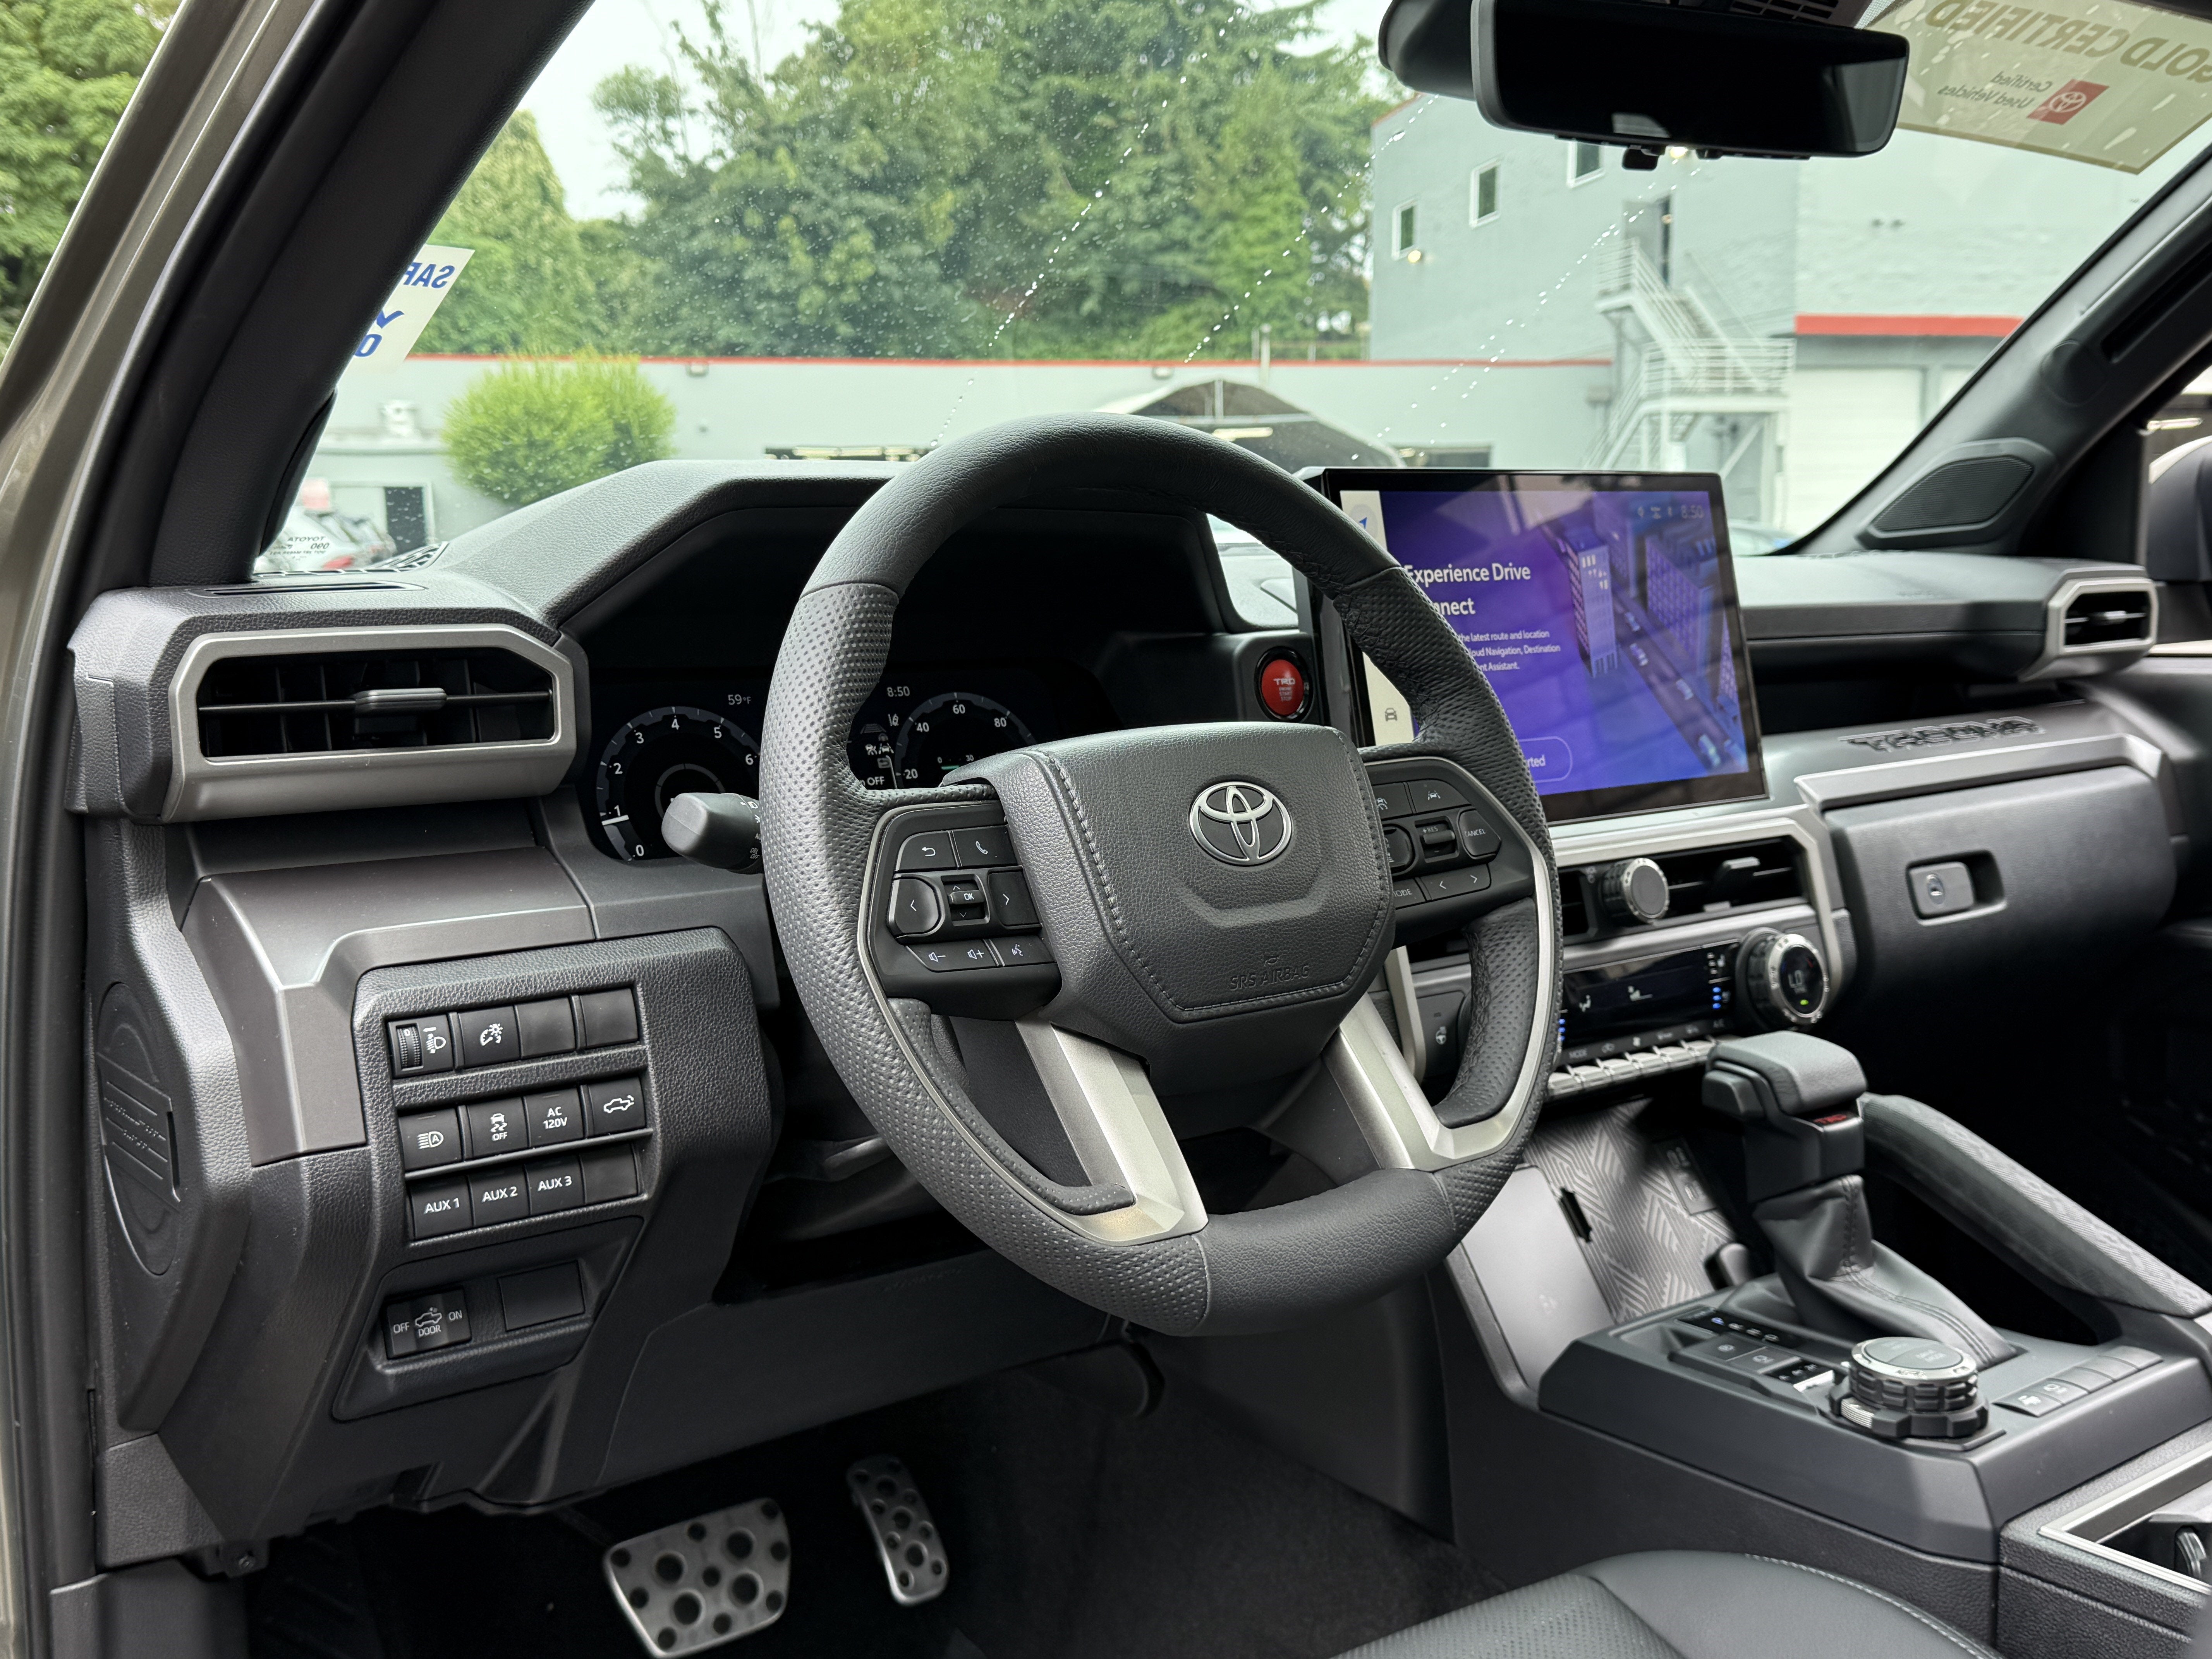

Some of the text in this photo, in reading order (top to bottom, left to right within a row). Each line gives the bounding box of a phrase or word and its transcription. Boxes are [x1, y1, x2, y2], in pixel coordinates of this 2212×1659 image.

[1492, 562, 1531, 581] Drive
[1470, 632, 1490, 642] latest
[1491, 632, 1508, 641] route
[1510, 631, 1522, 639] and
[1523, 629, 1550, 639] location
[1523, 644, 1561, 654] Destination
[887, 686, 910, 697] 8:50
[953, 704, 965, 714] 60
[672, 718, 680, 730] 4
[916, 722, 929, 733] 40
[994, 717, 1007, 728] 80
[635, 732, 644, 744] 3
[714, 727, 722, 738] 5
[745, 754, 754, 765] 6
[613, 763, 623, 775] 2
[905, 768, 918, 780] 20
[867, 776, 885, 786] OFF
[614, 805, 621, 816] 1
[1465, 829, 1486, 837] CANCEL
[635, 844, 645, 857] 0
[1230, 965, 1310, 991] SRS AIRBAG
[547, 1107, 562, 1118] AC
[543, 1117, 568, 1130] 120V
[492, 1132, 508, 1141] OFF
[538, 1176, 572, 1191] AUX 3
[482, 1186, 518, 1202] AUX 2
[424, 1198, 460, 1214] AUX 1
[449, 1310, 463, 1321] ON
[393, 1322, 410, 1334] OFF
[418, 1325, 441, 1337] DOOR
